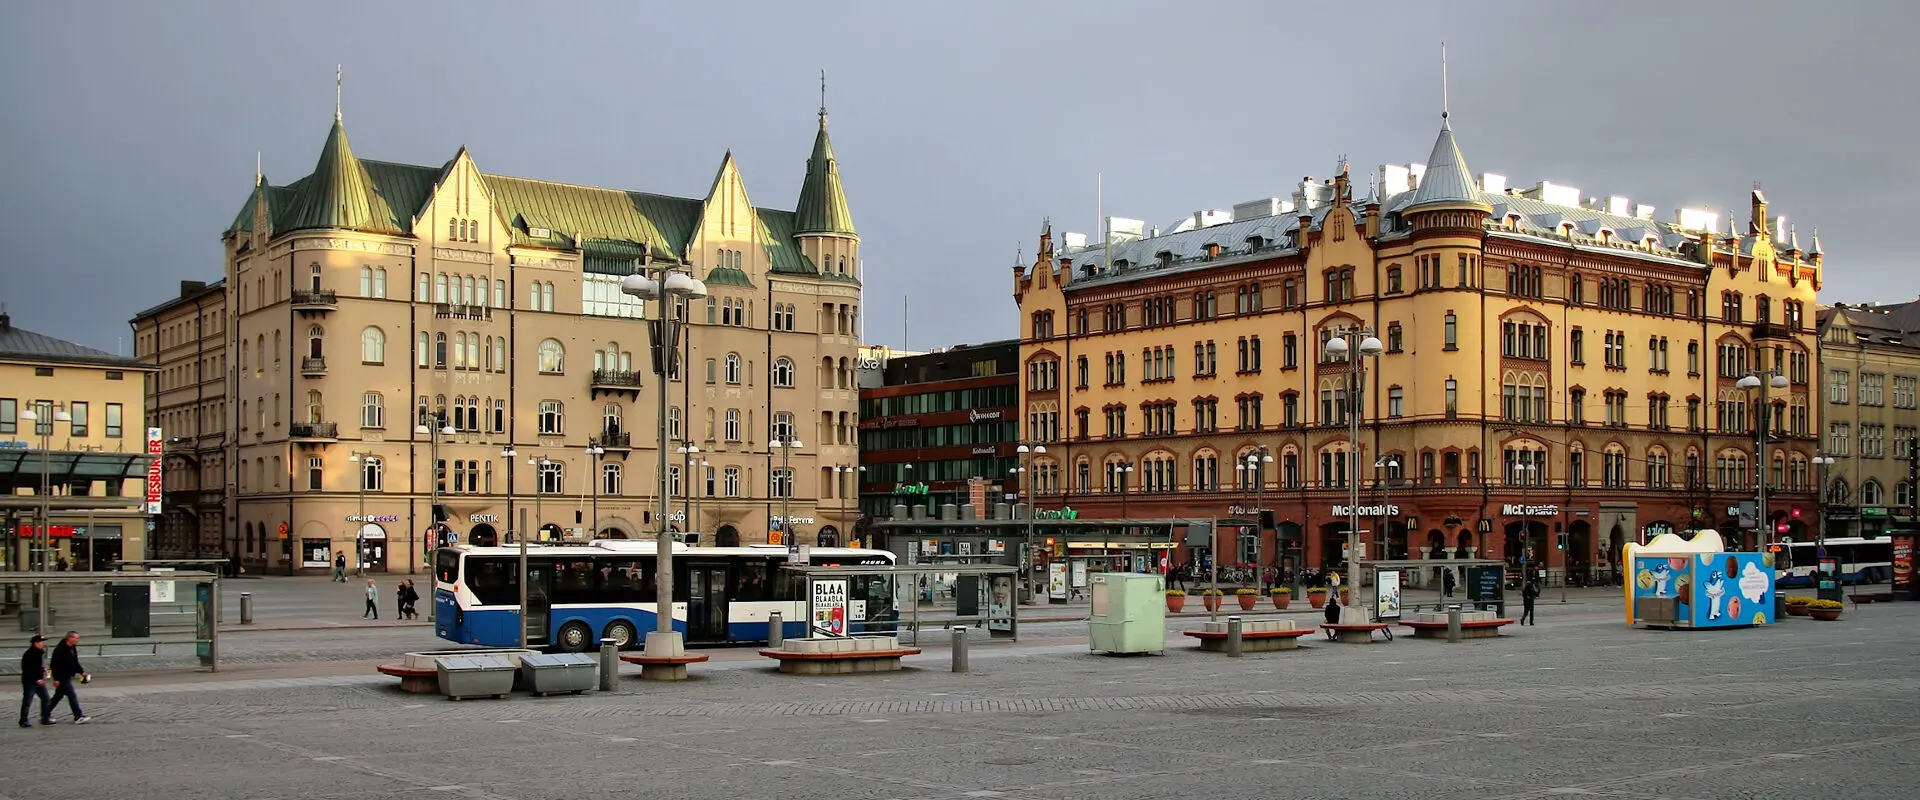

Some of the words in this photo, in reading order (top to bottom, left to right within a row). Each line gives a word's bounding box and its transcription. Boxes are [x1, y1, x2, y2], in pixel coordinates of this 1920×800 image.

[148, 439, 163, 502] HESBURER
[470, 514, 499, 522] PENTIK
[790, 515, 814, 524] Femme
[816, 584, 843, 595] BLAA
